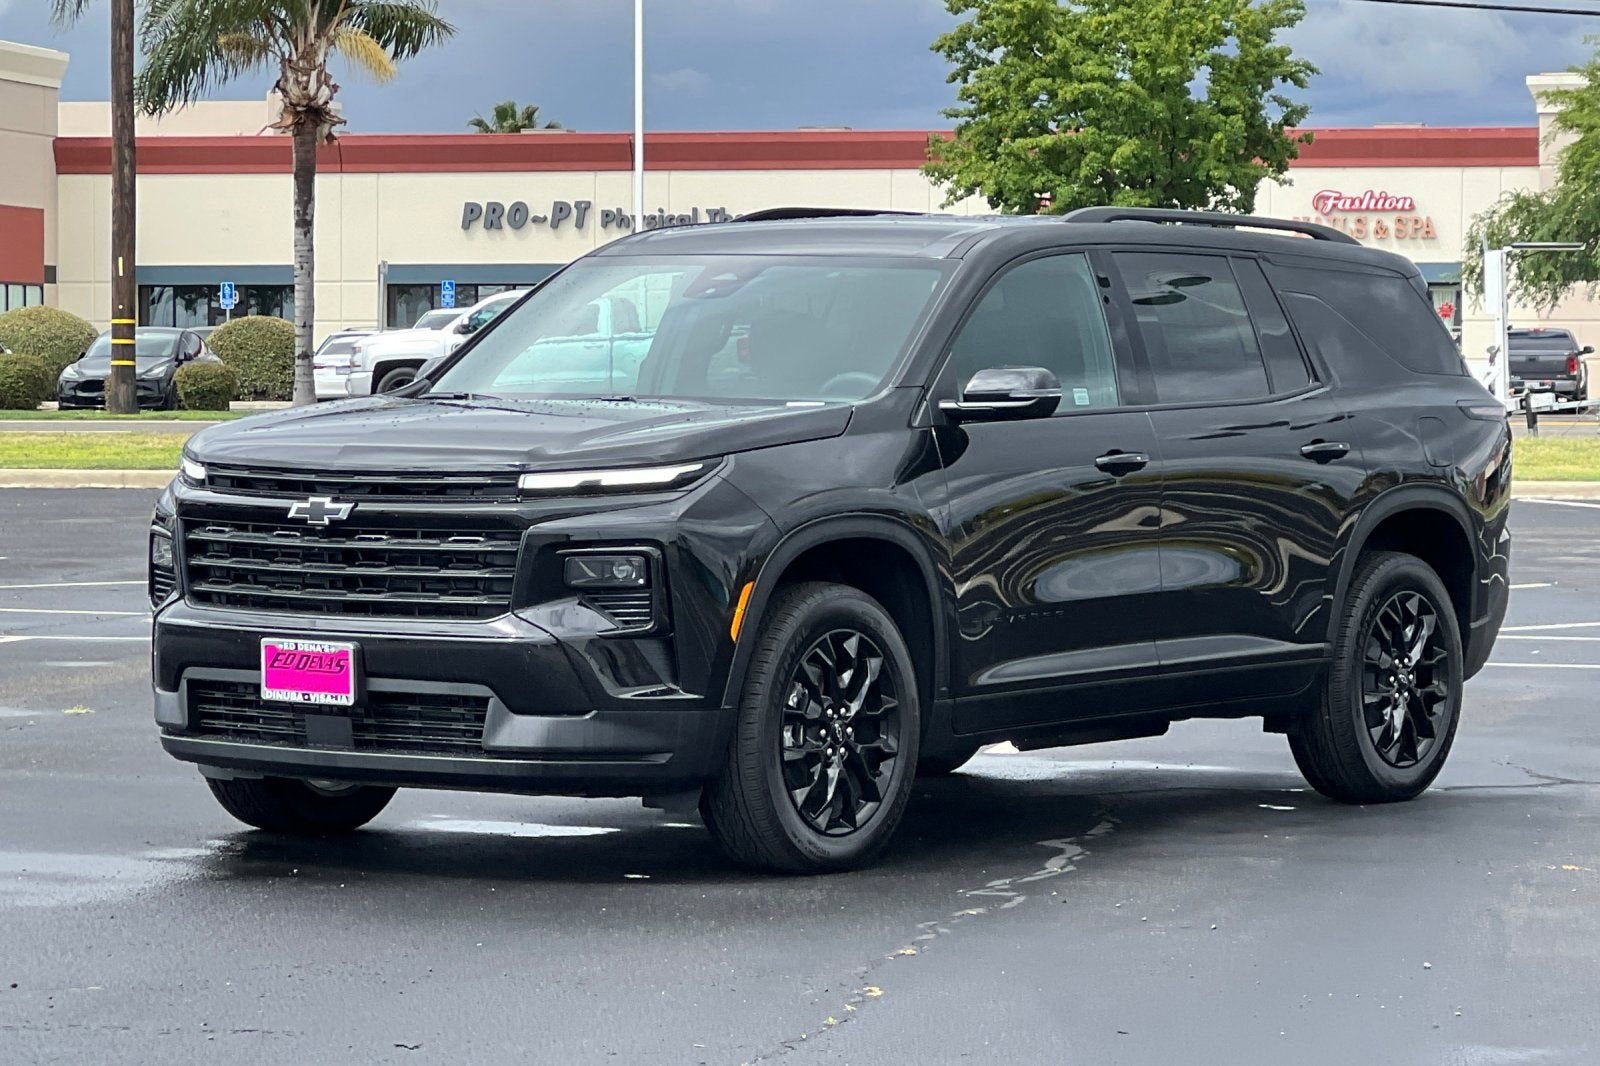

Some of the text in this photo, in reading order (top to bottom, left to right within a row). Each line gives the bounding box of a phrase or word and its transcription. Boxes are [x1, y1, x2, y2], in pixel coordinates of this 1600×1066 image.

[1313, 190, 1415, 215] Fashion
[1375, 218, 1389, 239] &
[1395, 216, 1437, 239] SPA
[269, 652, 297, 669] ED
[266, 690, 303, 702] DINUBA
